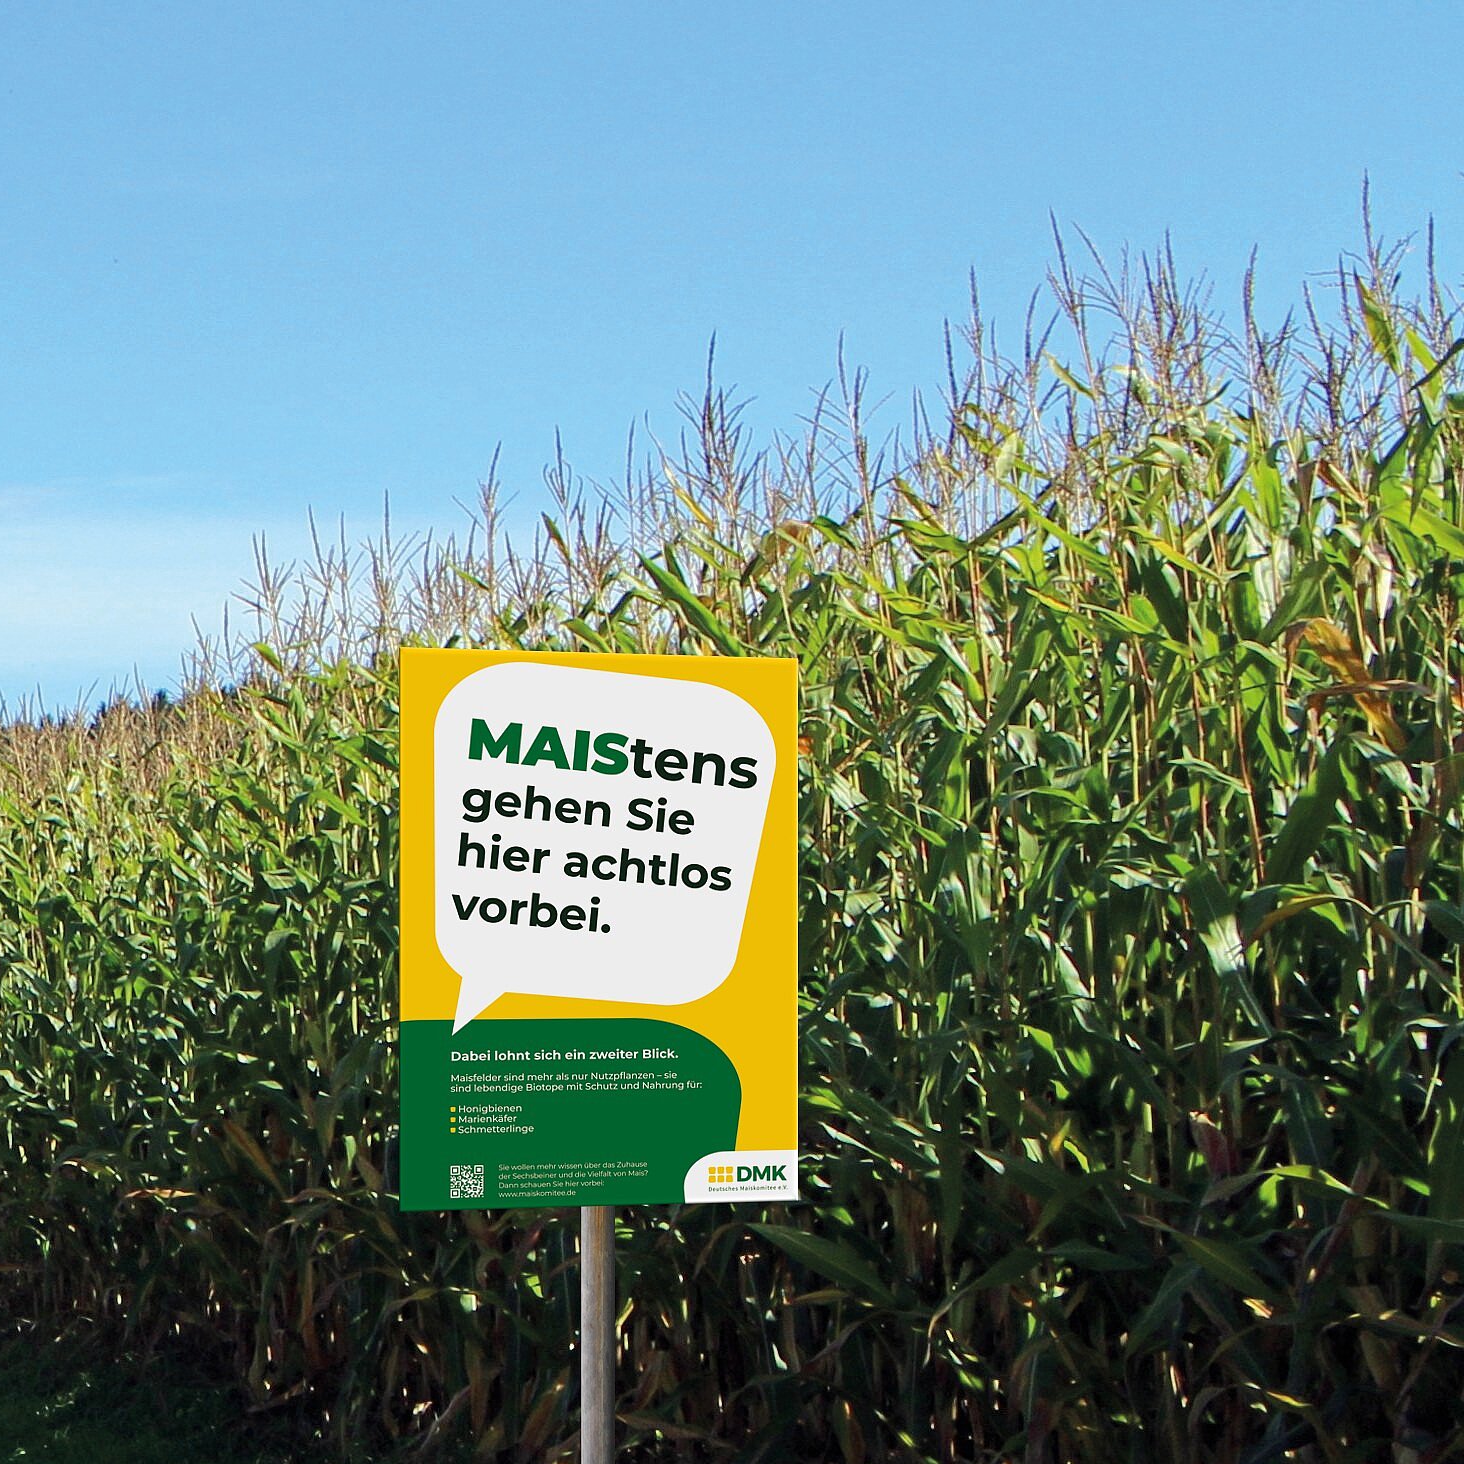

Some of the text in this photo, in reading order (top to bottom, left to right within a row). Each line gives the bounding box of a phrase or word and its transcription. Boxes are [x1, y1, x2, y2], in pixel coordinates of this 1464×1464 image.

[468, 718, 758, 789] MAIStens
[462, 786, 695, 834] gehen Sie
[457, 833, 732, 890] hier achtlos
[452, 893, 611, 933] vorbei.
[451, 1048, 679, 1062] Dabei lohnt sich ein zweiter Blick.
[451, 1073, 502, 1082] Maisfelder
[503, 1072, 525, 1082] sind
[527, 1072, 554, 1081] mehr
[556, 1072, 570, 1081] als
[590, 1071, 655, 1081] Nutzpflanzen
[664, 1070, 678, 1079] sie
[450, 1080, 702, 1094] sind lebendige Biotope mit Schutz und Nahrung für:
[458, 1104, 522, 1114] Honigbienen
[458, 1114, 517, 1124] Marienkäfer
[458, 1124, 534, 1134] Schmetterlinge
[736, 1165, 787, 1182] DMK
[498, 1189, 576, 1198] www.maiskomitee.de
